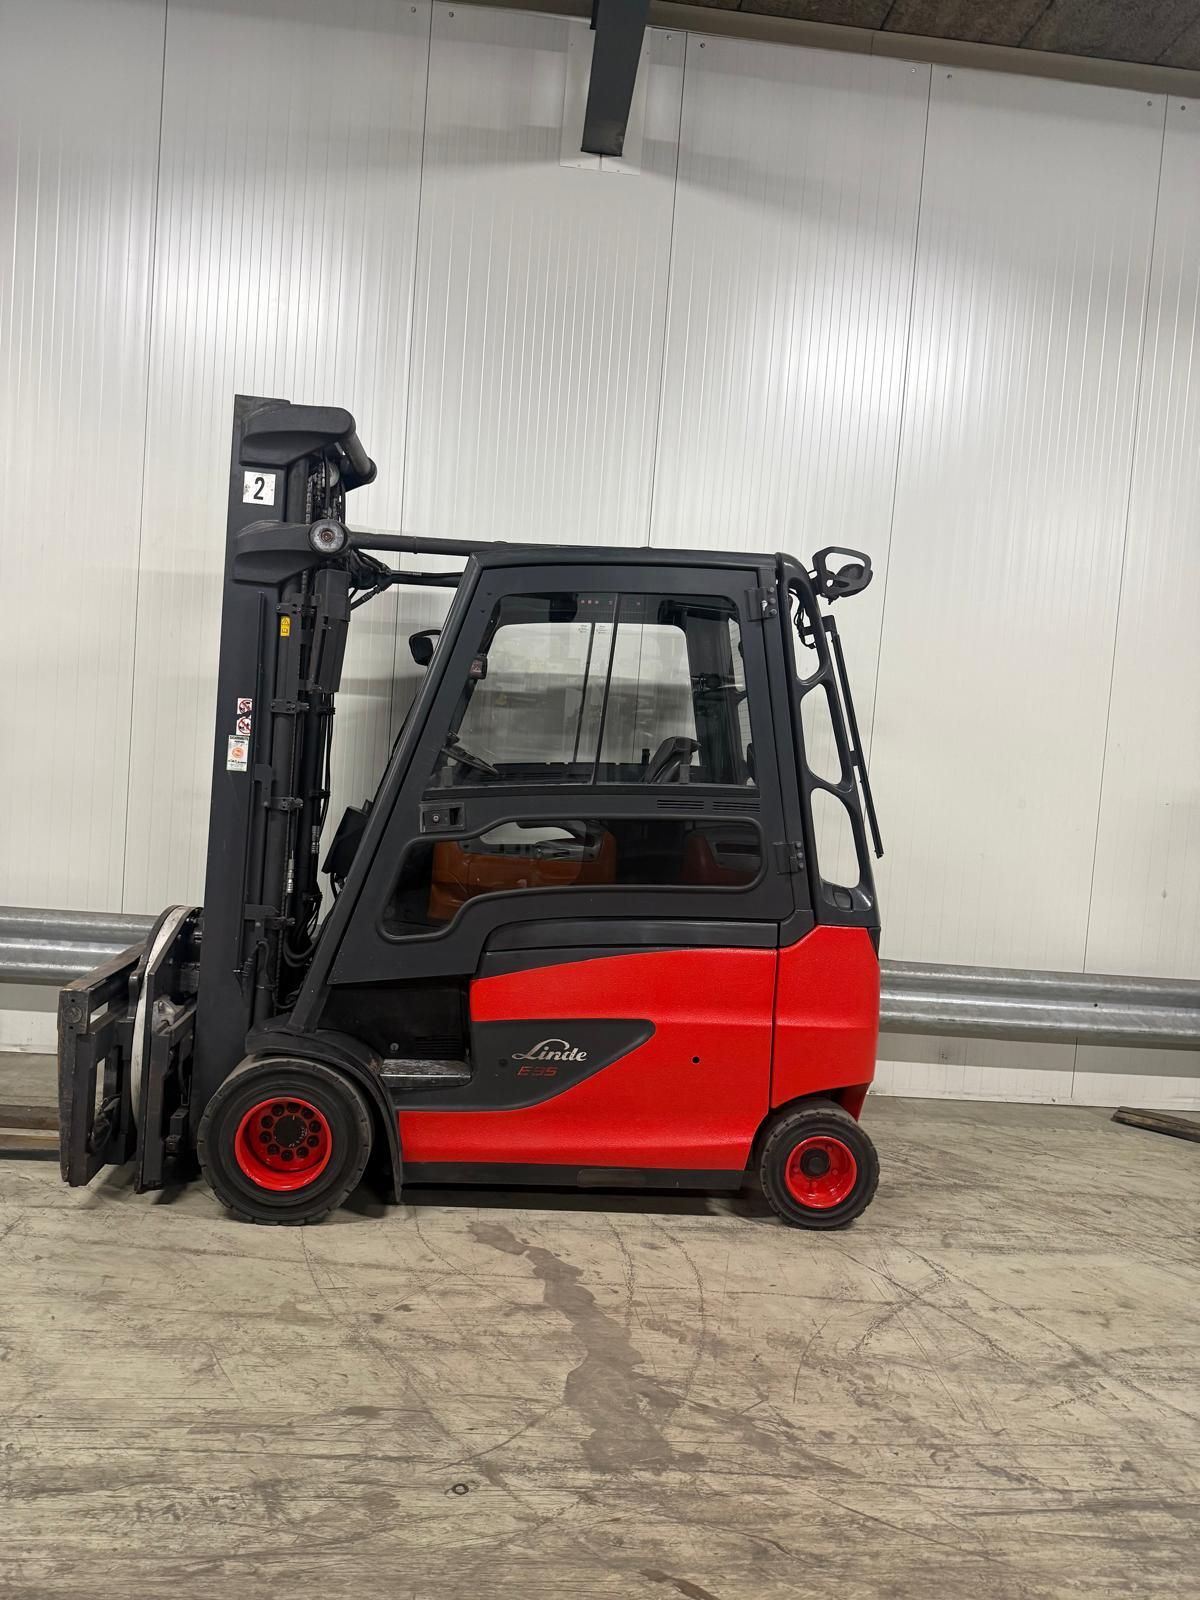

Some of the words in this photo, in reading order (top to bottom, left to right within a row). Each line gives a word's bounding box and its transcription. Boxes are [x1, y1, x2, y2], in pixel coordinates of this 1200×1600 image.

[254, 476, 265, 501] 2
[511, 1038, 588, 1062] Linde
[517, 1066, 558, 1077] E35
